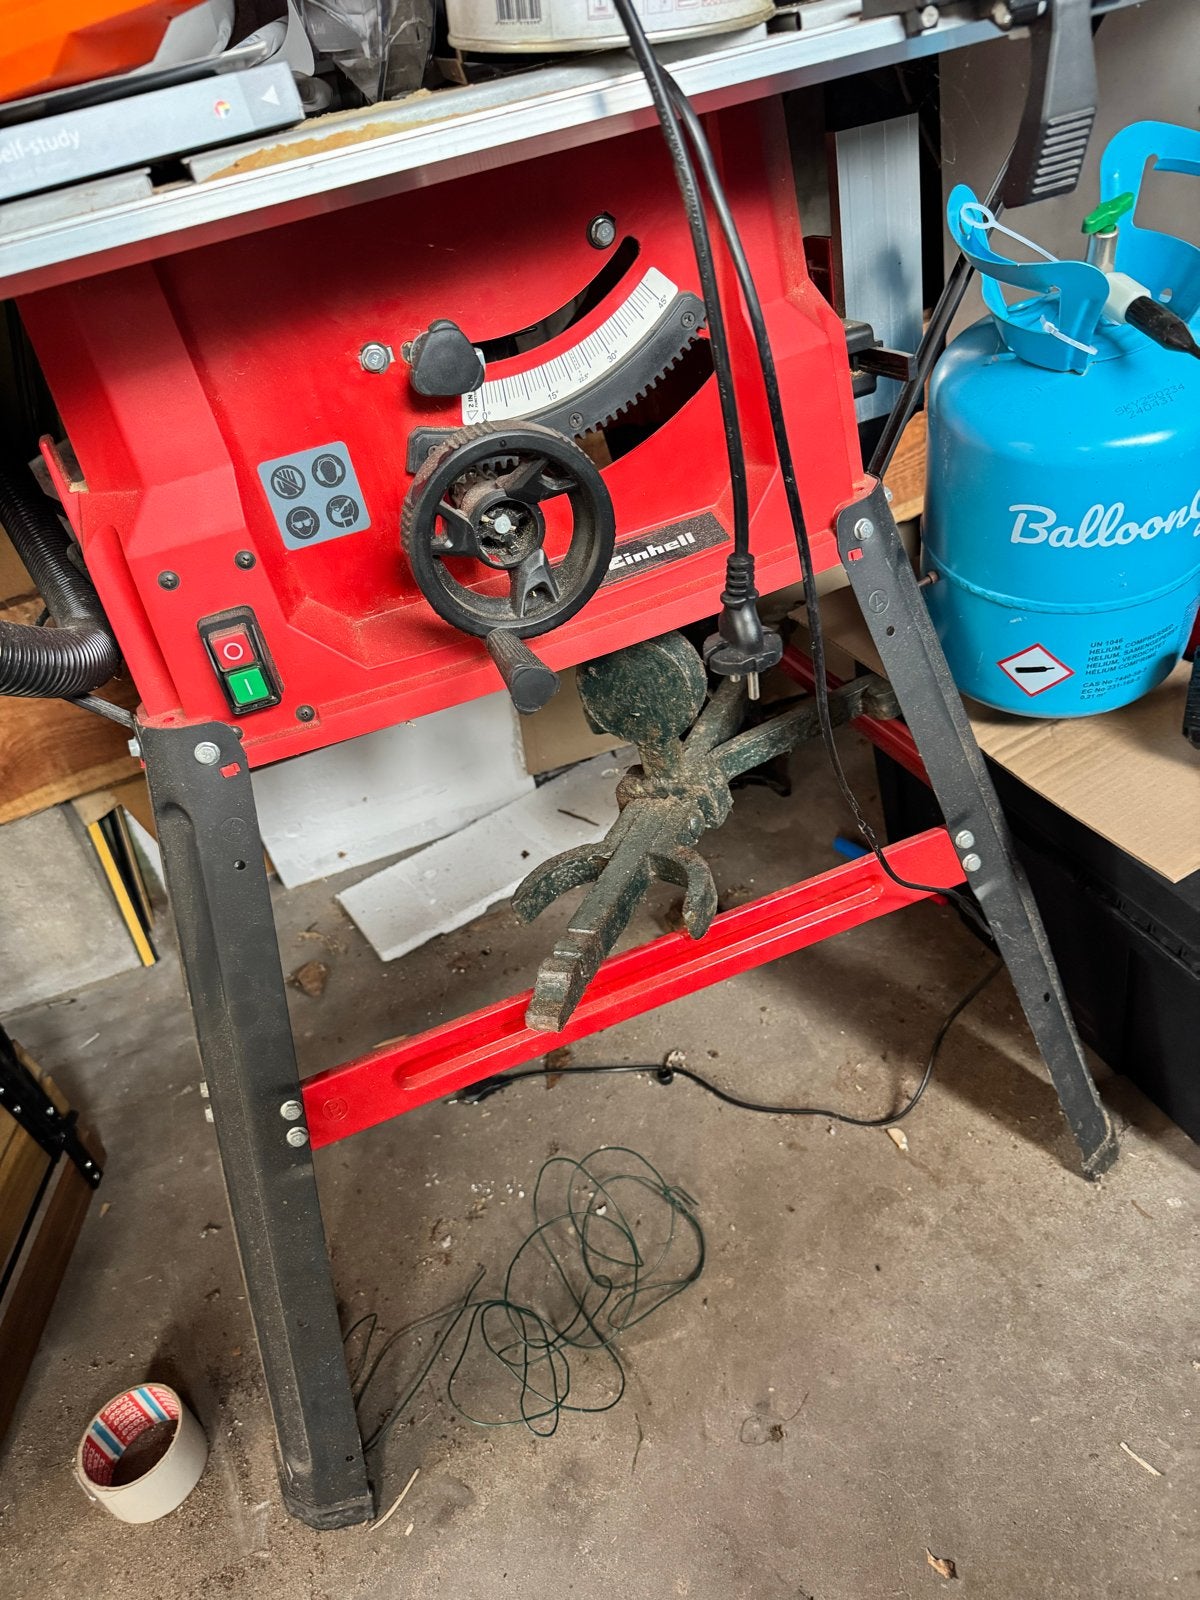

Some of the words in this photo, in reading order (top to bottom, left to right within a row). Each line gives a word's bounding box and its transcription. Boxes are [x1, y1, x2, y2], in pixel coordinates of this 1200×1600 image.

[0, 128, 80, 163] elf-study
[606, 350, 618, 363] 30°
[547, 389, 559, 401] 15°
[608, 531, 696, 571] Einhell
[1105, 637, 1124, 647] 1046
